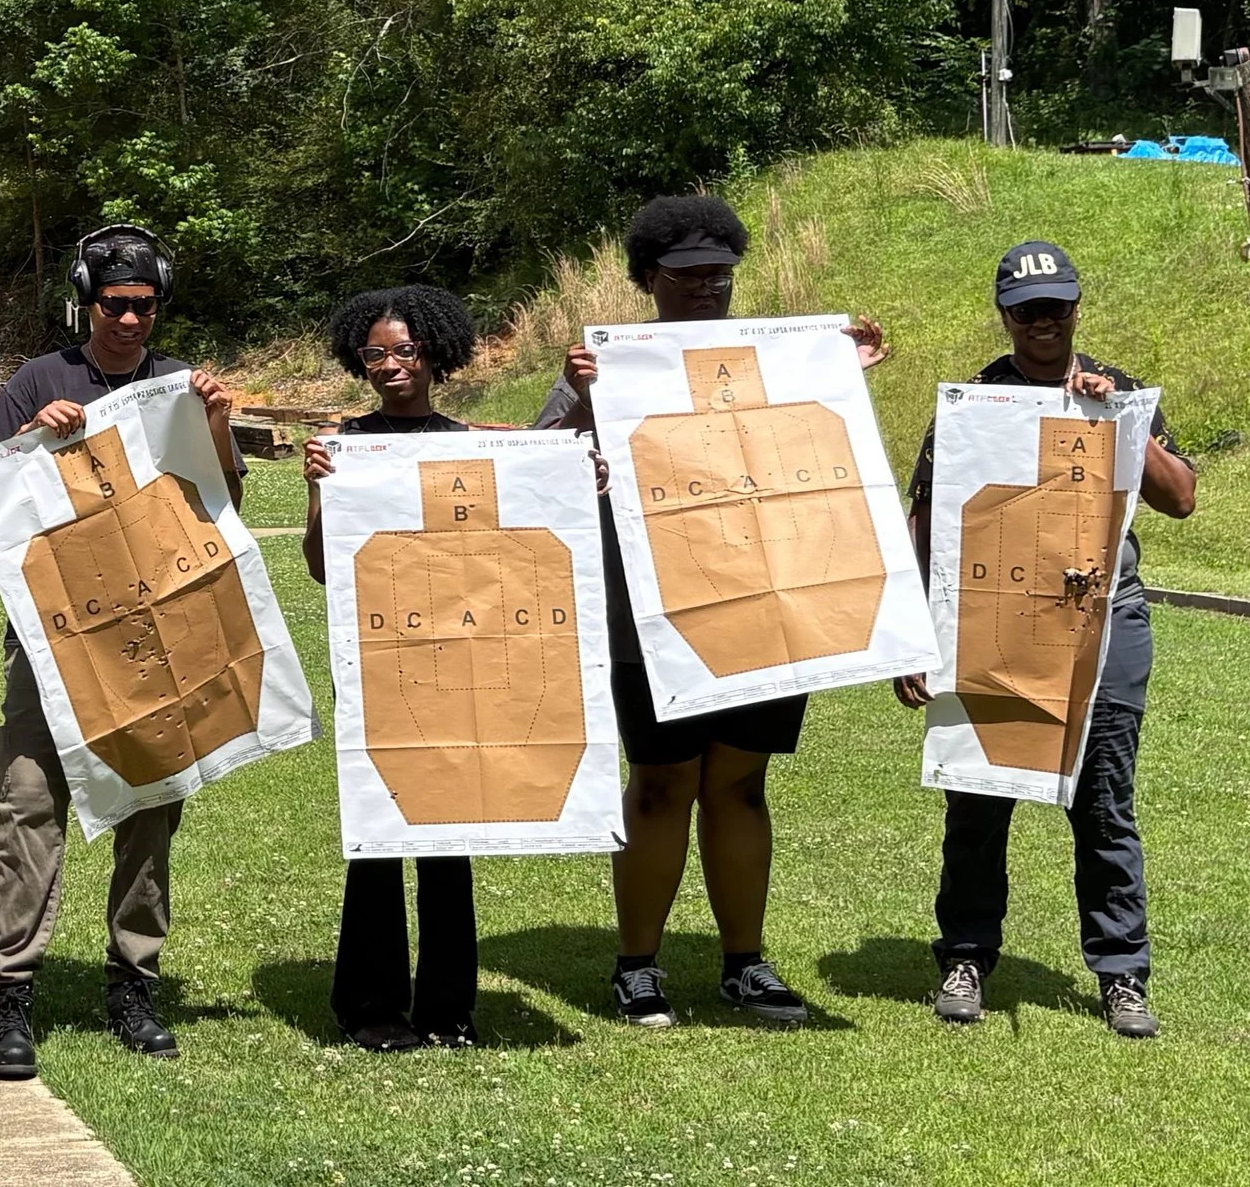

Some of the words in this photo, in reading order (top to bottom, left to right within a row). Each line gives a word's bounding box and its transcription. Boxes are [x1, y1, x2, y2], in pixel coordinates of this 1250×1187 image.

[1013, 253, 1058, 279] JLB
[716, 363, 731, 379] A
[721, 389, 735, 403] B
[1071, 437, 1086, 453] A
[91, 455, 105, 472] A
[1071, 466, 1085, 482] B
[100, 482, 116, 500] B
[451, 477, 467, 493] A
[651, 487, 666, 503] D
[688, 480, 703, 496] C
[743, 475, 758, 489] A
[796, 469, 811, 483] C
[833, 466, 848, 480] D
[454, 505, 468, 522] B
[972, 563, 987, 580] D
[1010, 566, 1025, 583] C
[53, 613, 67, 630] D
[86, 599, 101, 615] C
[137, 579, 151, 597] A
[176, 557, 190, 573] C
[203, 541, 219, 558] D
[370, 613, 384, 630] D
[407, 612, 422, 628] C
[462, 610, 477, 627] A
[515, 609, 529, 625] C
[552, 608, 566, 625] D
